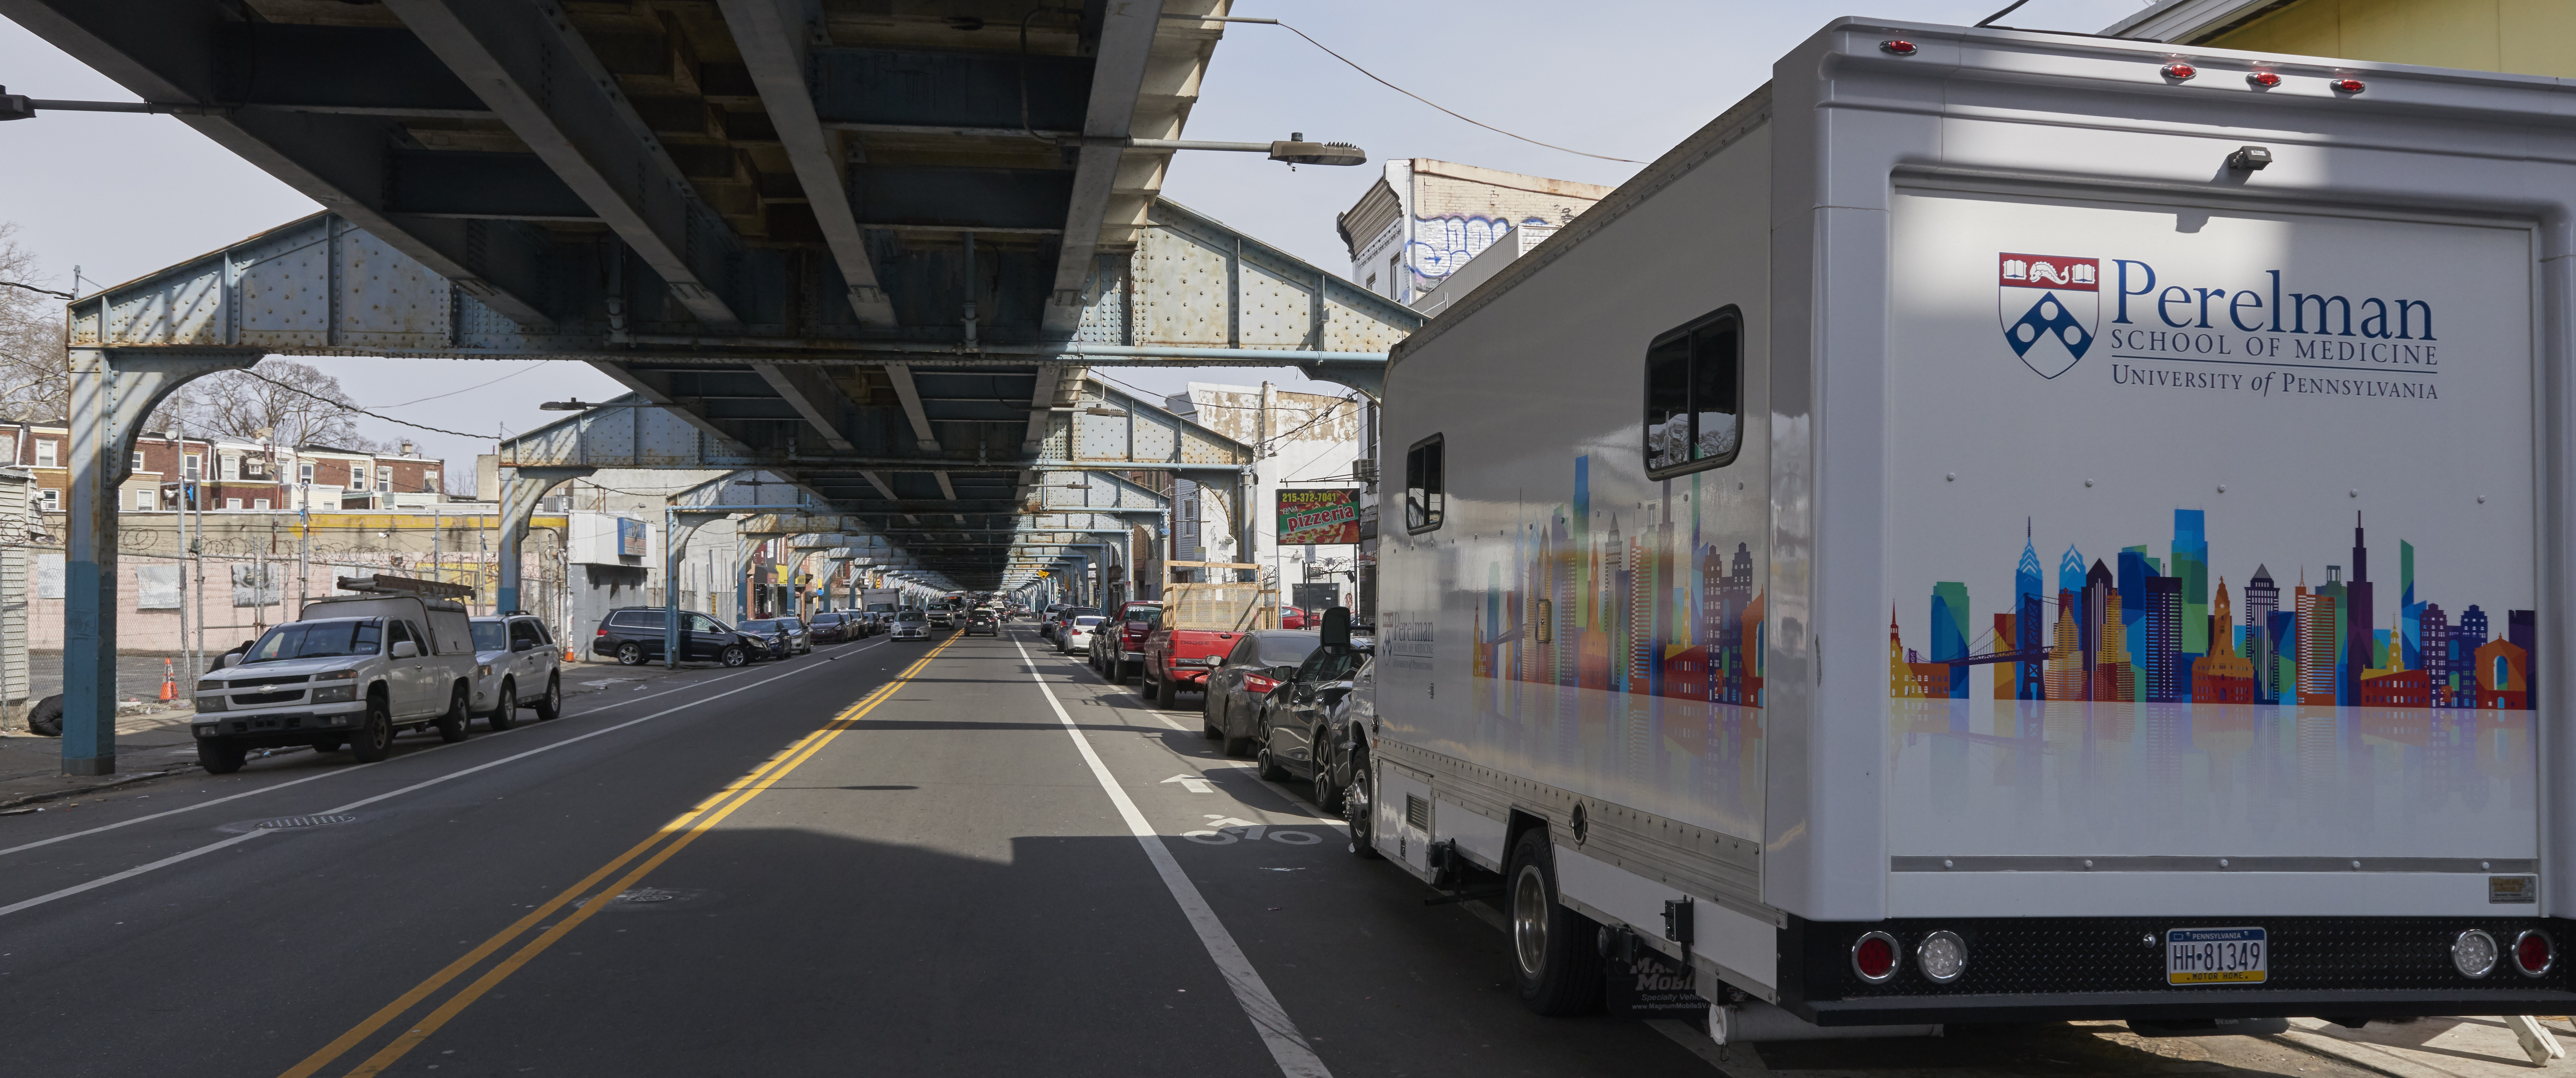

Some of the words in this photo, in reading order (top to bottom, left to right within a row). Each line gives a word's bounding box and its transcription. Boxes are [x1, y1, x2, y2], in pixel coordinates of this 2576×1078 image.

[2112, 258, 2438, 341] Perelman
[2112, 329, 2231, 355] SCHOOL
[2246, 336, 2280, 357] OF
[2294, 339, 2437, 365] MEDICINE
[2251, 372, 2276, 397] of
[1282, 493, 1337, 502] 215-372-7041
[1282, 506, 1298, 515] DNA
[1287, 505, 1355, 533] pizzeria
[1394, 612, 1433, 642] Perelman
[1393, 643, 1407, 653] SCHOOL
[1409, 644, 1413, 653] OF
[1414, 644, 1433, 654] MEDICINE
[1642, 994, 1677, 1002] Specialty
